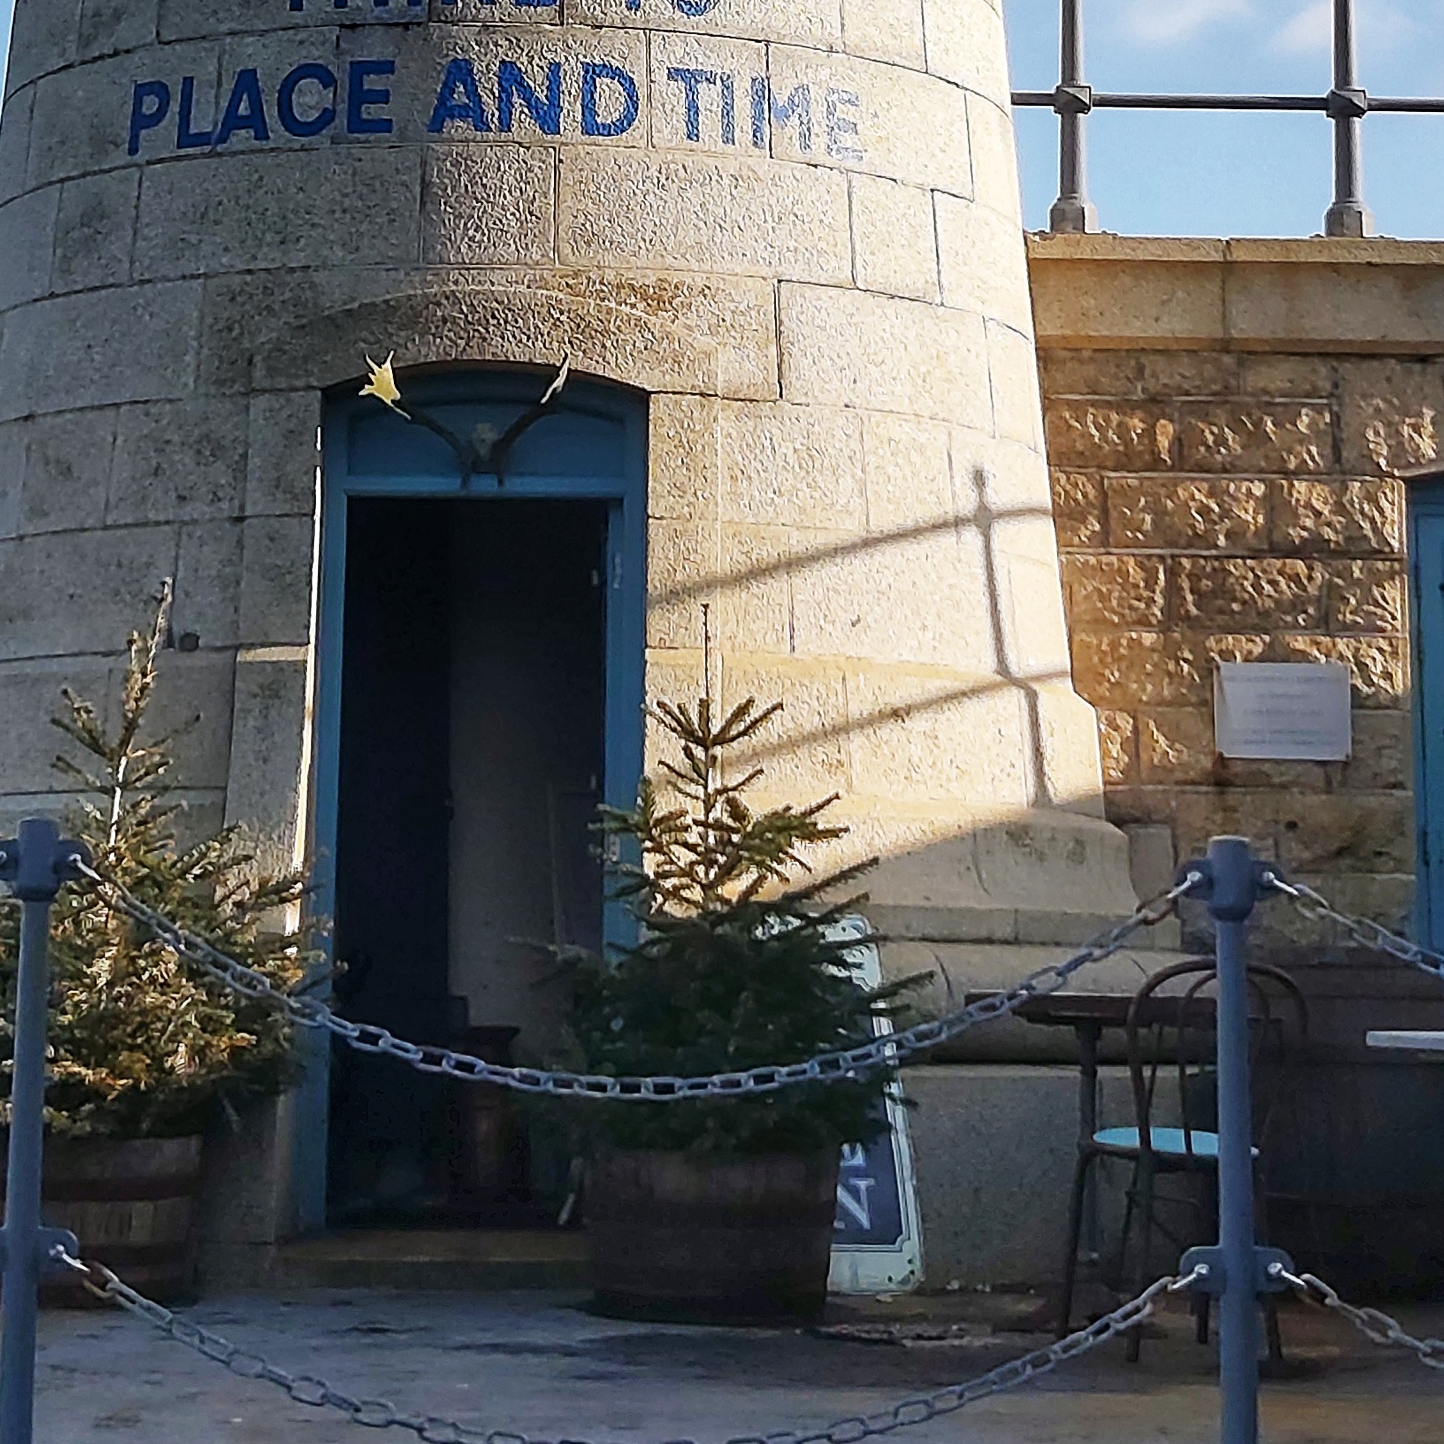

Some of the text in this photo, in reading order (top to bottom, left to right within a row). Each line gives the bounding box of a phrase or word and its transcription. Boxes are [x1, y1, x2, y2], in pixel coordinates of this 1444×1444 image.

[126, 55, 865, 163] PLACE AND TIME
